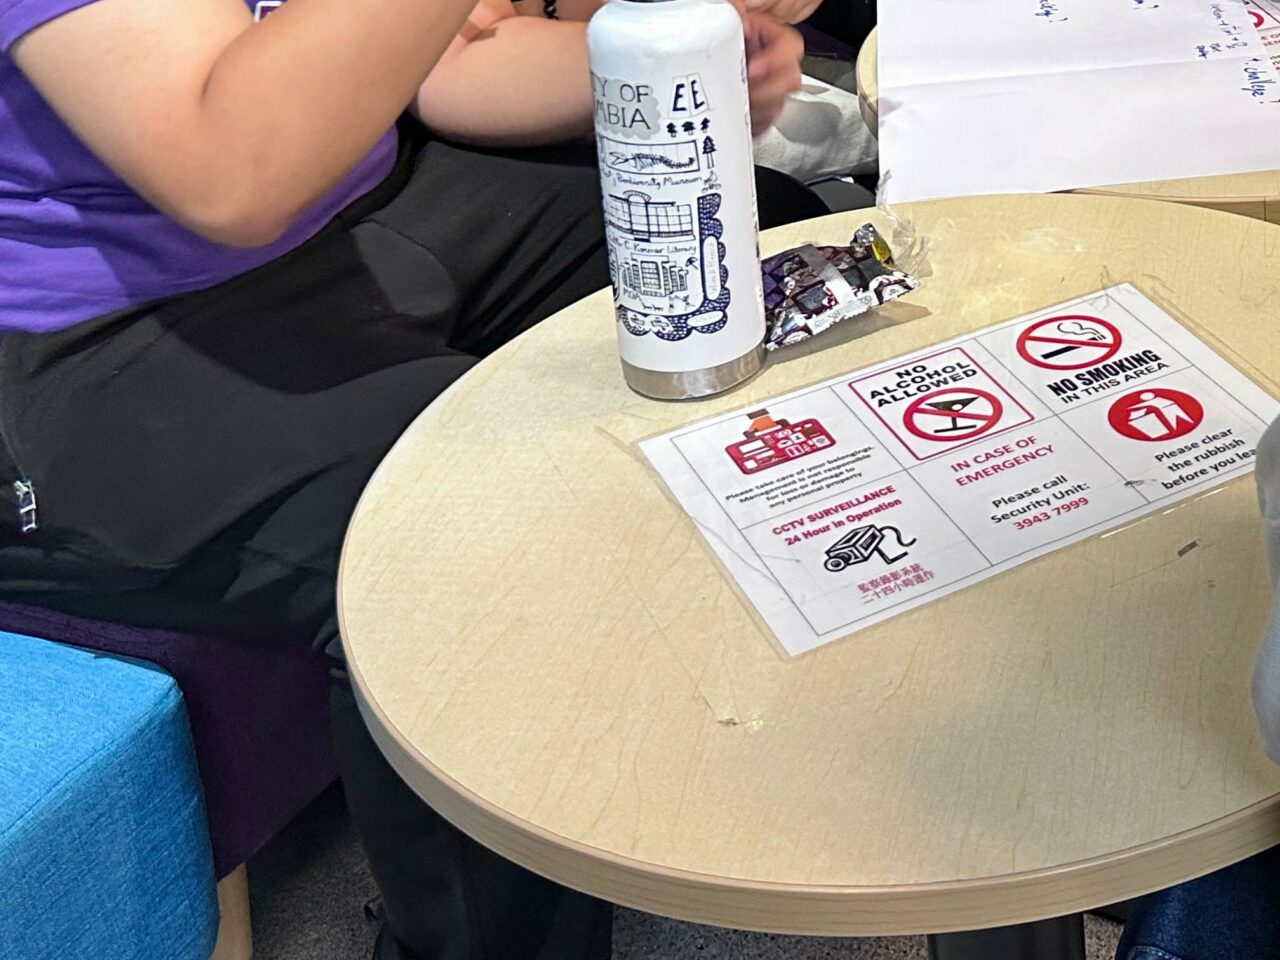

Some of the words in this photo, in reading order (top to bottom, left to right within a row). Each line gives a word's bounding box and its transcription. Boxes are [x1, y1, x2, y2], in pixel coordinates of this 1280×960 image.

[620, 83, 649, 103] OF
[596, 99, 651, 130] MBIA
[870, 361, 971, 399] ALCOHOL
[877, 368, 978, 408] ALLOWED
[896, 364, 927, 379] NO
[1047, 377, 1078, 397] NO
[1075, 349, 1162, 386] SMOKING
[1060, 392, 1081, 404] IN
[1080, 378, 1121, 396] THIS
[1124, 362, 1170, 383] AREA
[950, 460, 971, 473] IN
[973, 444, 1013, 465] CASE
[1016, 435, 1038, 449] OF
[1154, 440, 1201, 463] Please
[1201, 427, 1234, 445] clear
[1167, 458, 1193, 473] the
[1194, 437, 1246, 463] rubbish
[725, 487, 755, 500] Please
[755, 480, 775, 490] take
[775, 472, 795, 482] care
[795, 468, 806, 476] of
[806, 462, 826, 473] your
[739, 479, 798, 503] Management
[807, 470, 823, 479] not
[823, 453, 872, 475] responsible
[955, 443, 1055, 487] EMERGENCY
[1161, 465, 1209, 490] before
[1210, 456, 1237, 474] you
[1238, 448, 1257, 461] lea
[765, 493, 780, 501] for
[780, 486, 799, 496] loss
[810, 470, 845, 487] damage
[768, 499, 786, 509] any
[786, 486, 826, 503] personal
[825, 472, 863, 490] property
[991, 496, 1051, 525] Security
[1053, 482, 1091, 501] Unit:
[992, 486, 1040, 509] Please
[1043, 474, 1069, 491] call
[772, 519, 805, 535] CCTV
[806, 485, 897, 523] SURVEILLANCE
[784, 533, 803, 546] 24
[802, 525, 831, 542] Hour
[832, 520, 846, 530] in
[846, 498, 903, 523] Operation
[1013, 510, 1052, 531] 3943
[1055, 496, 1090, 519] 7999
